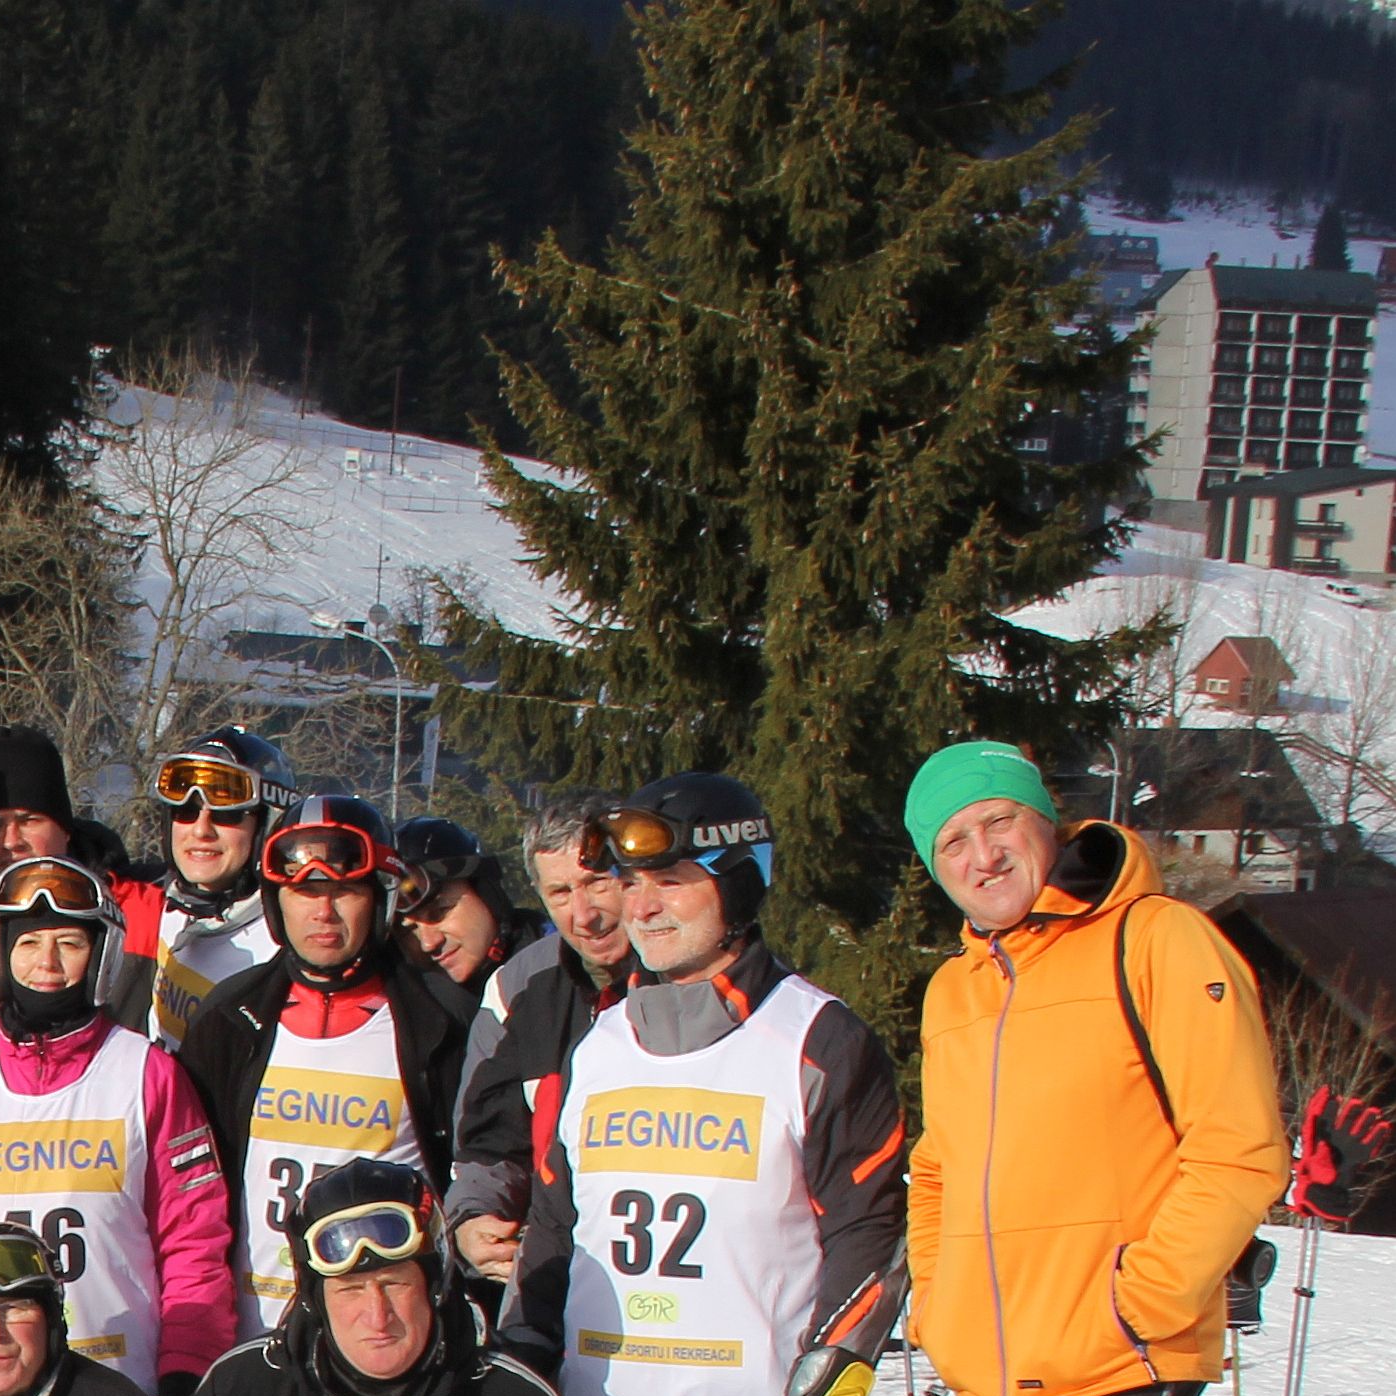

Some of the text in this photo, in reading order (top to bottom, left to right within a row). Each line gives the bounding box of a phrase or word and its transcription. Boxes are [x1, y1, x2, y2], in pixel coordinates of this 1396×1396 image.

[693, 819, 769, 848] uvex
[253, 1087, 392, 1130] EGNICA
[584, 1110, 751, 1155] LEGNICA
[5, 1207, 87, 1283] 6
[610, 1189, 707, 1279] 32
[625, 1341, 665, 1357] SPORTU
[672, 1346, 736, 1362] REKREACJI
